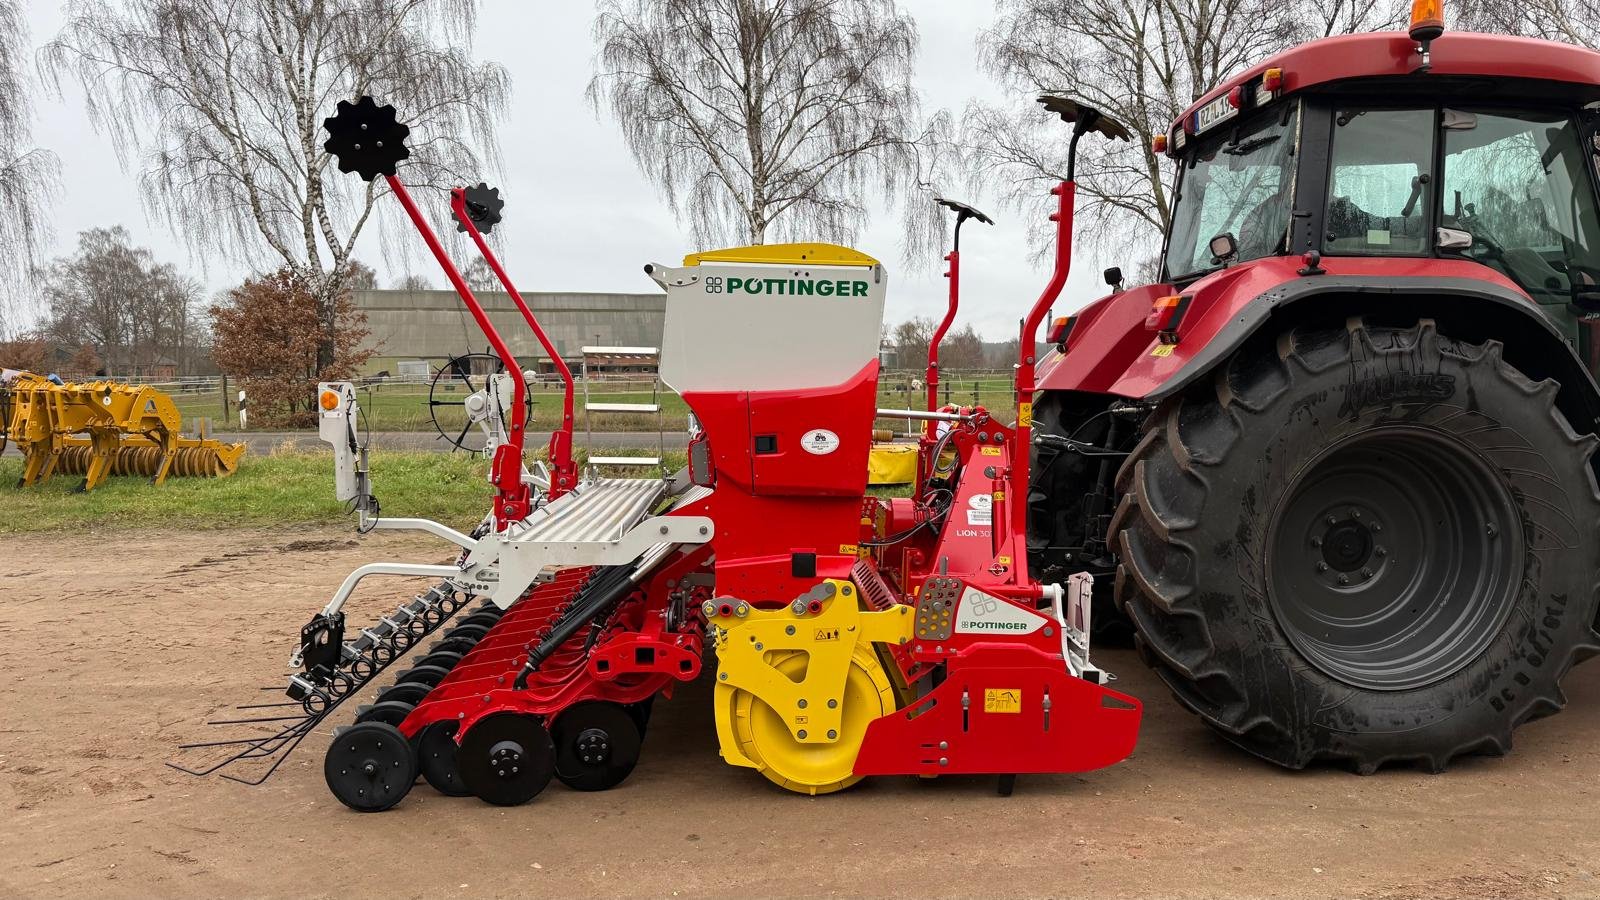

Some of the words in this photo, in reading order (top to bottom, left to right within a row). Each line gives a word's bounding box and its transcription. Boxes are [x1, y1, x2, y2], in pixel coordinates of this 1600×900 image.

[1201, 107, 1210, 127] RZ
[727, 277, 869, 297] PÖTTINGER
[956, 529, 977, 537] LION
